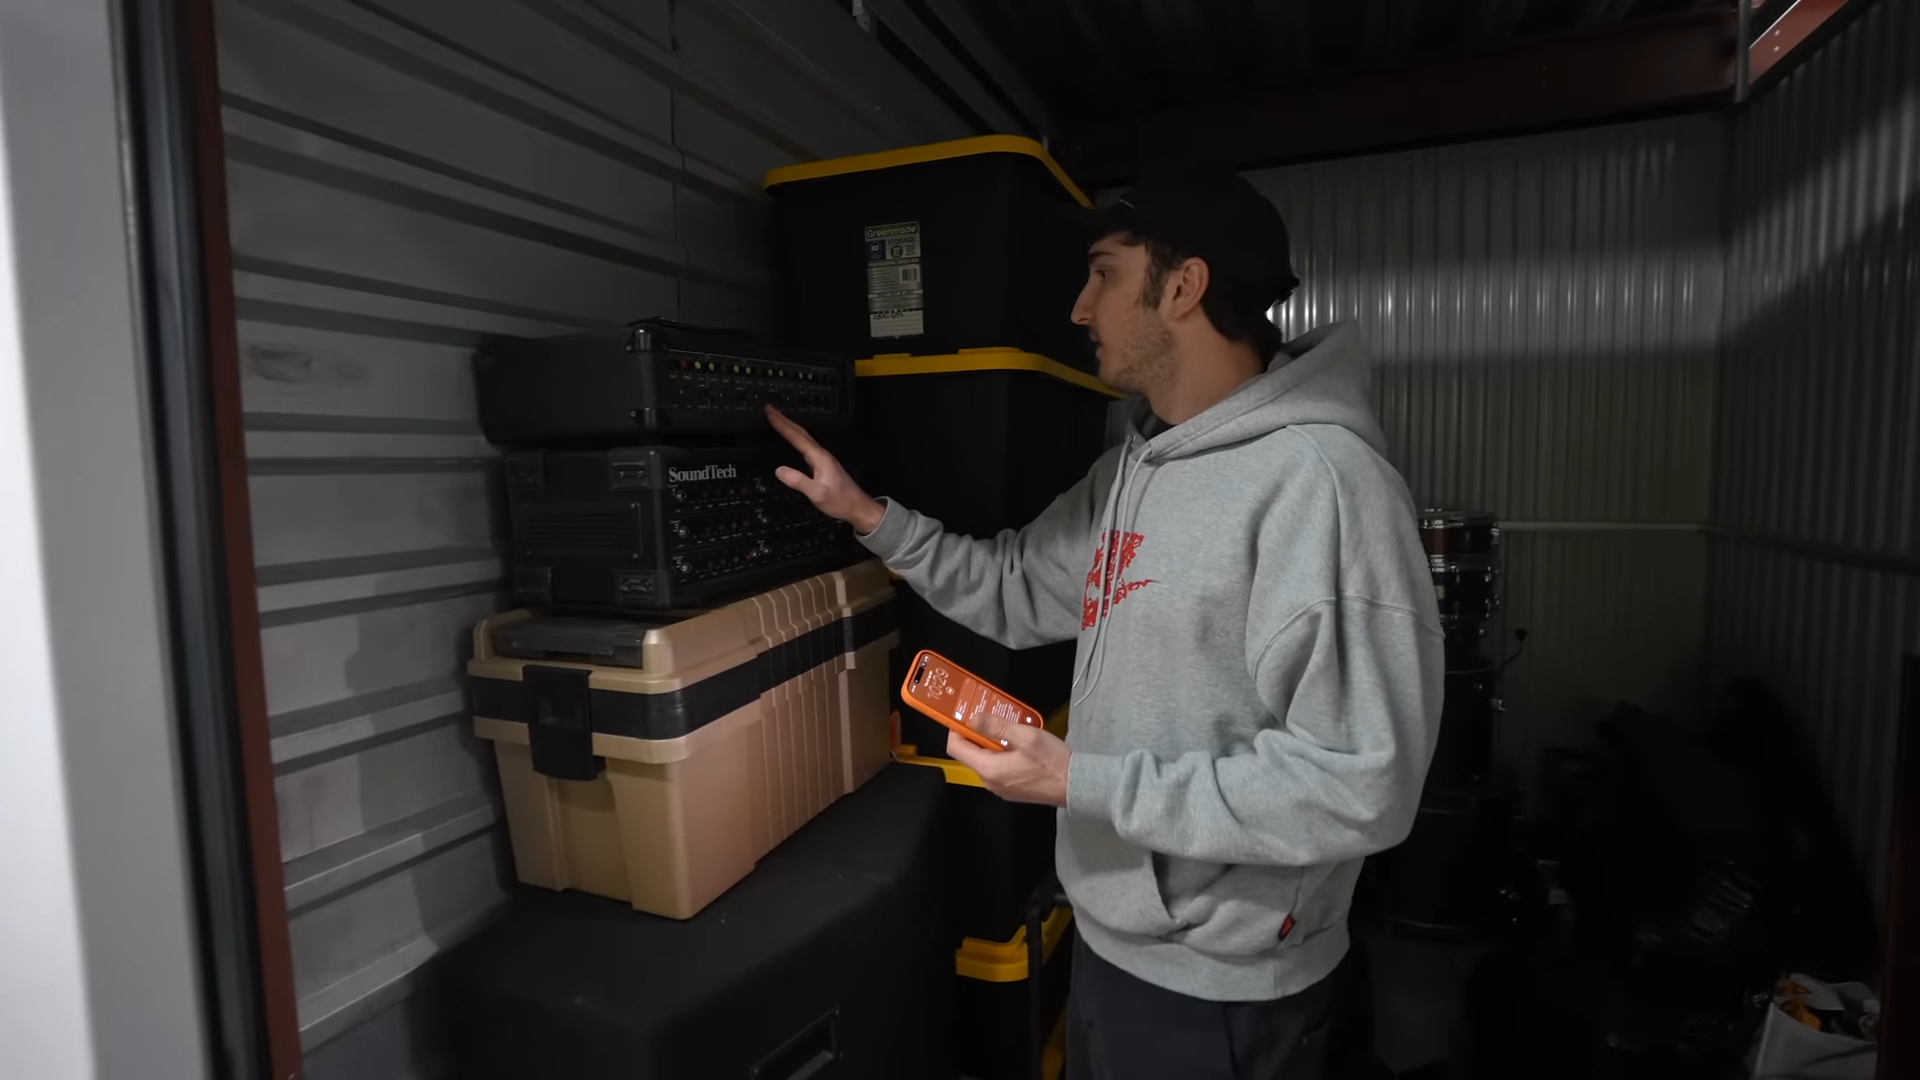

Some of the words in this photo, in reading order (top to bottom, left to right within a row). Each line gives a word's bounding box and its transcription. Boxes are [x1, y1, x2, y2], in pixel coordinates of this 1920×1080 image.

[867, 224, 916, 238] Greenmade
[668, 463, 737, 483] SoundTech
[926, 667, 949, 700] 10:29
